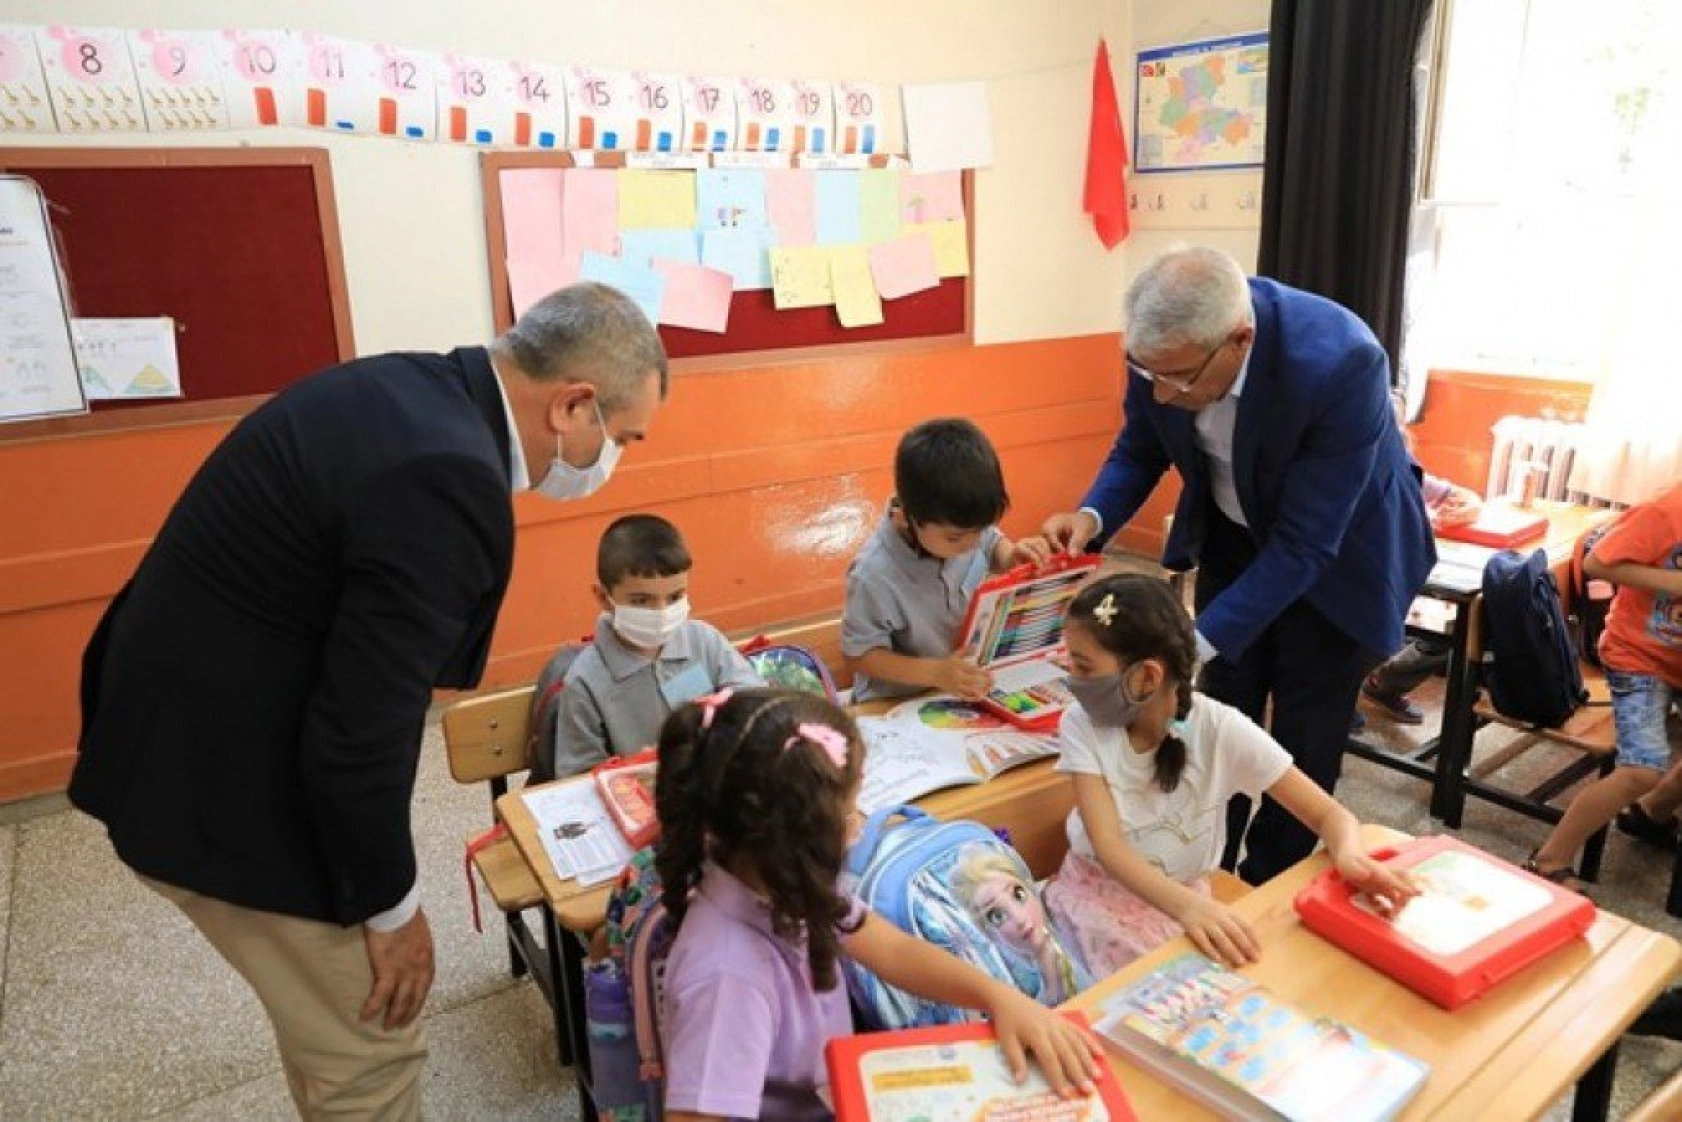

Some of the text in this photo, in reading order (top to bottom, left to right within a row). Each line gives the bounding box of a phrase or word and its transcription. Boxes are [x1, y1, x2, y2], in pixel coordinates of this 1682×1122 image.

[79, 43, 103, 75] 8
[170, 45, 187, 75] 9
[242, 45, 277, 75] 10
[323, 52, 345, 79] 11
[388, 61, 417, 90] 12
[457, 71, 487, 97] 13
[520, 76, 550, 102] 14
[585, 81, 611, 107] 15
[643, 86, 668, 109] 16
[698, 88, 720, 110] 17
[752, 91, 775, 113] 18
[800, 93, 820, 115] 19
[848, 93, 873, 117] 20
